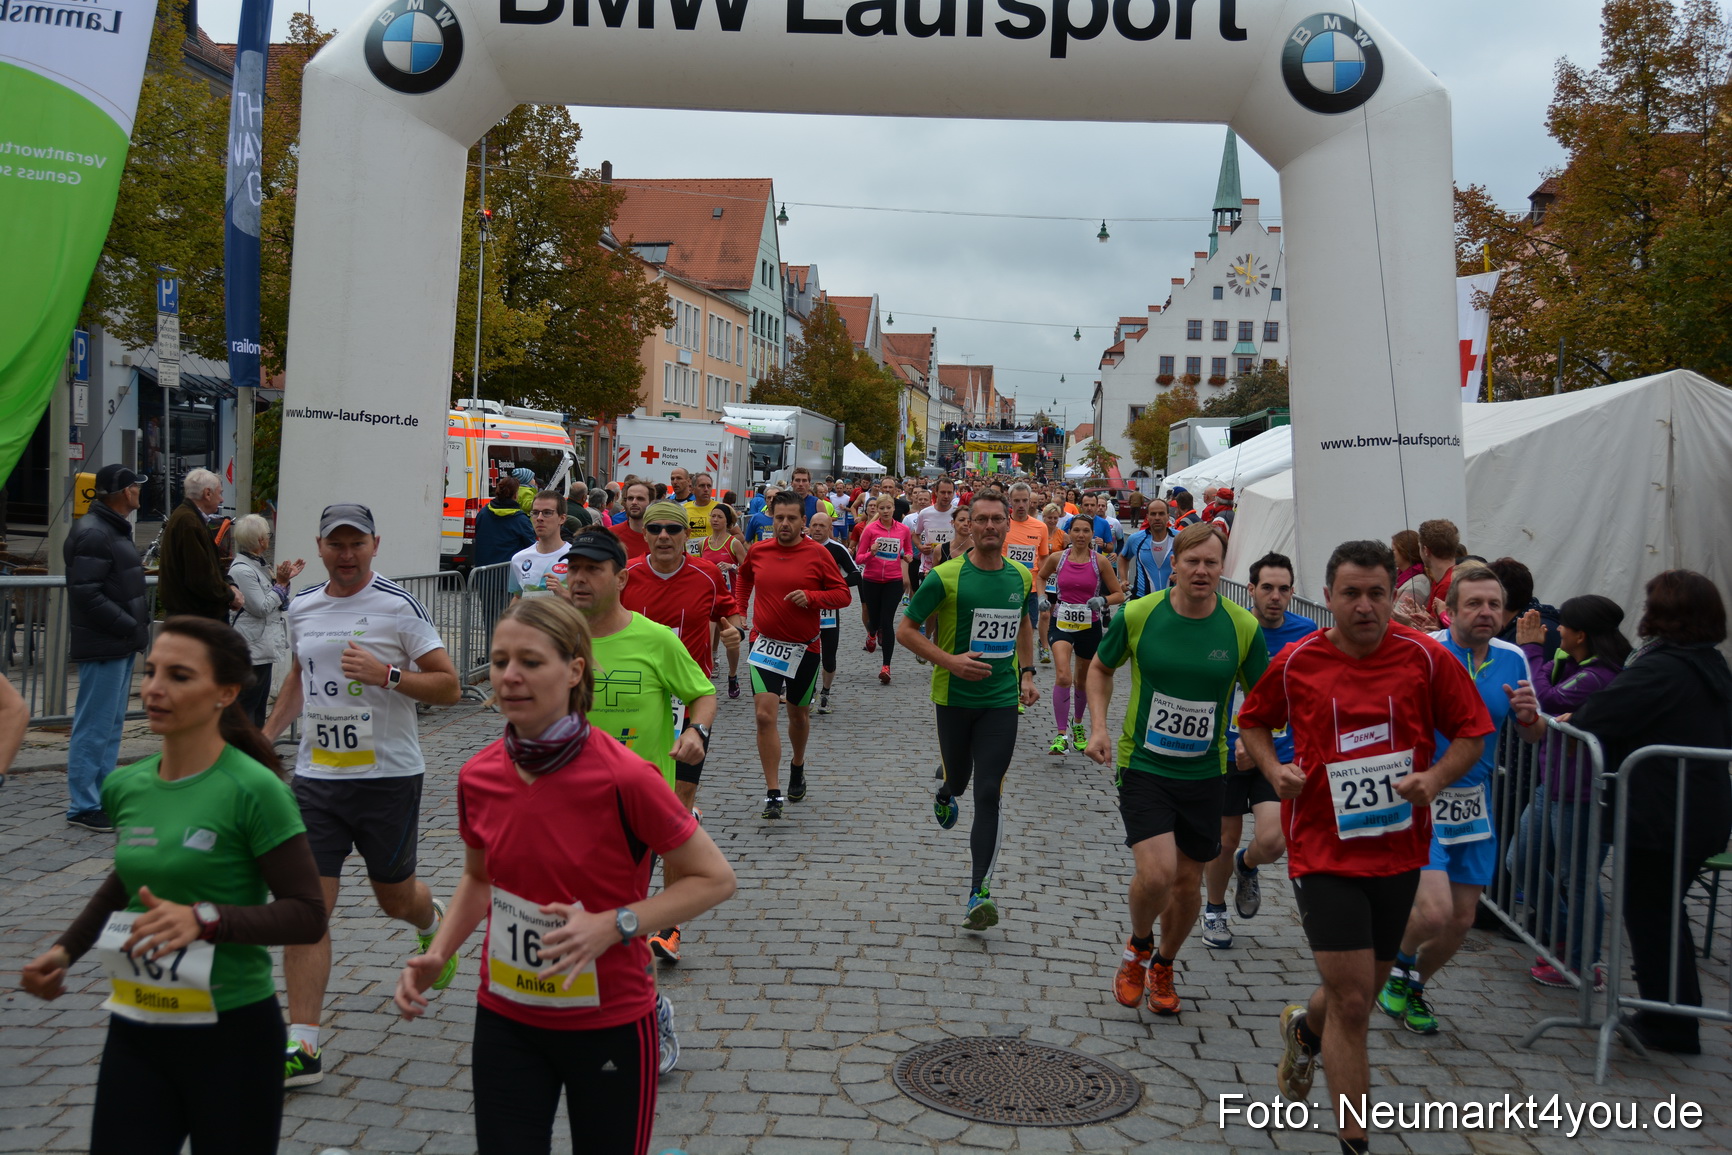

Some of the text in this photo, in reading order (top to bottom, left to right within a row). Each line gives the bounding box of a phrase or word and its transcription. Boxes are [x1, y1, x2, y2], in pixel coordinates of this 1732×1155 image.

[378, 0, 456, 28] BMW
[1291, 15, 1373, 48] BMW
[77, 337, 86, 374] P
[108, 399, 115, 415] 3
[285, 406, 419, 427] www.bmw-laufsport.de
[1320, 432, 1460, 450] www.bmw-laufsport.de
[662, 446, 698, 454] Bayerisches
[935, 534, 946, 542] 44
[878, 542, 898, 553] 2215
[1010, 550, 1034, 562] 2529
[1064, 610, 1085, 622] 386
[976, 620, 1018, 640] 2315
[757, 639, 793, 661] 2605
[984, 644, 1008, 652] Thomas
[1208, 650, 1229, 658] AOK
[310, 680, 363, 696] L G G
[1154, 698, 1207, 714] PARTL Neumarkt
[308, 712, 323, 720] PARTL
[1154, 708, 1210, 738] 2368
[316, 724, 358, 749] 516
[1160, 736, 1195, 750] Gerhard
[1353, 731, 1375, 744] DEHN
[1330, 761, 1402, 779] PARTL Neumarkt
[1363, 812, 1399, 826] Jürgen
[493, 897, 518, 917] PARTL
[516, 974, 556, 994] Anika
[134, 988, 180, 1010] Bettina
